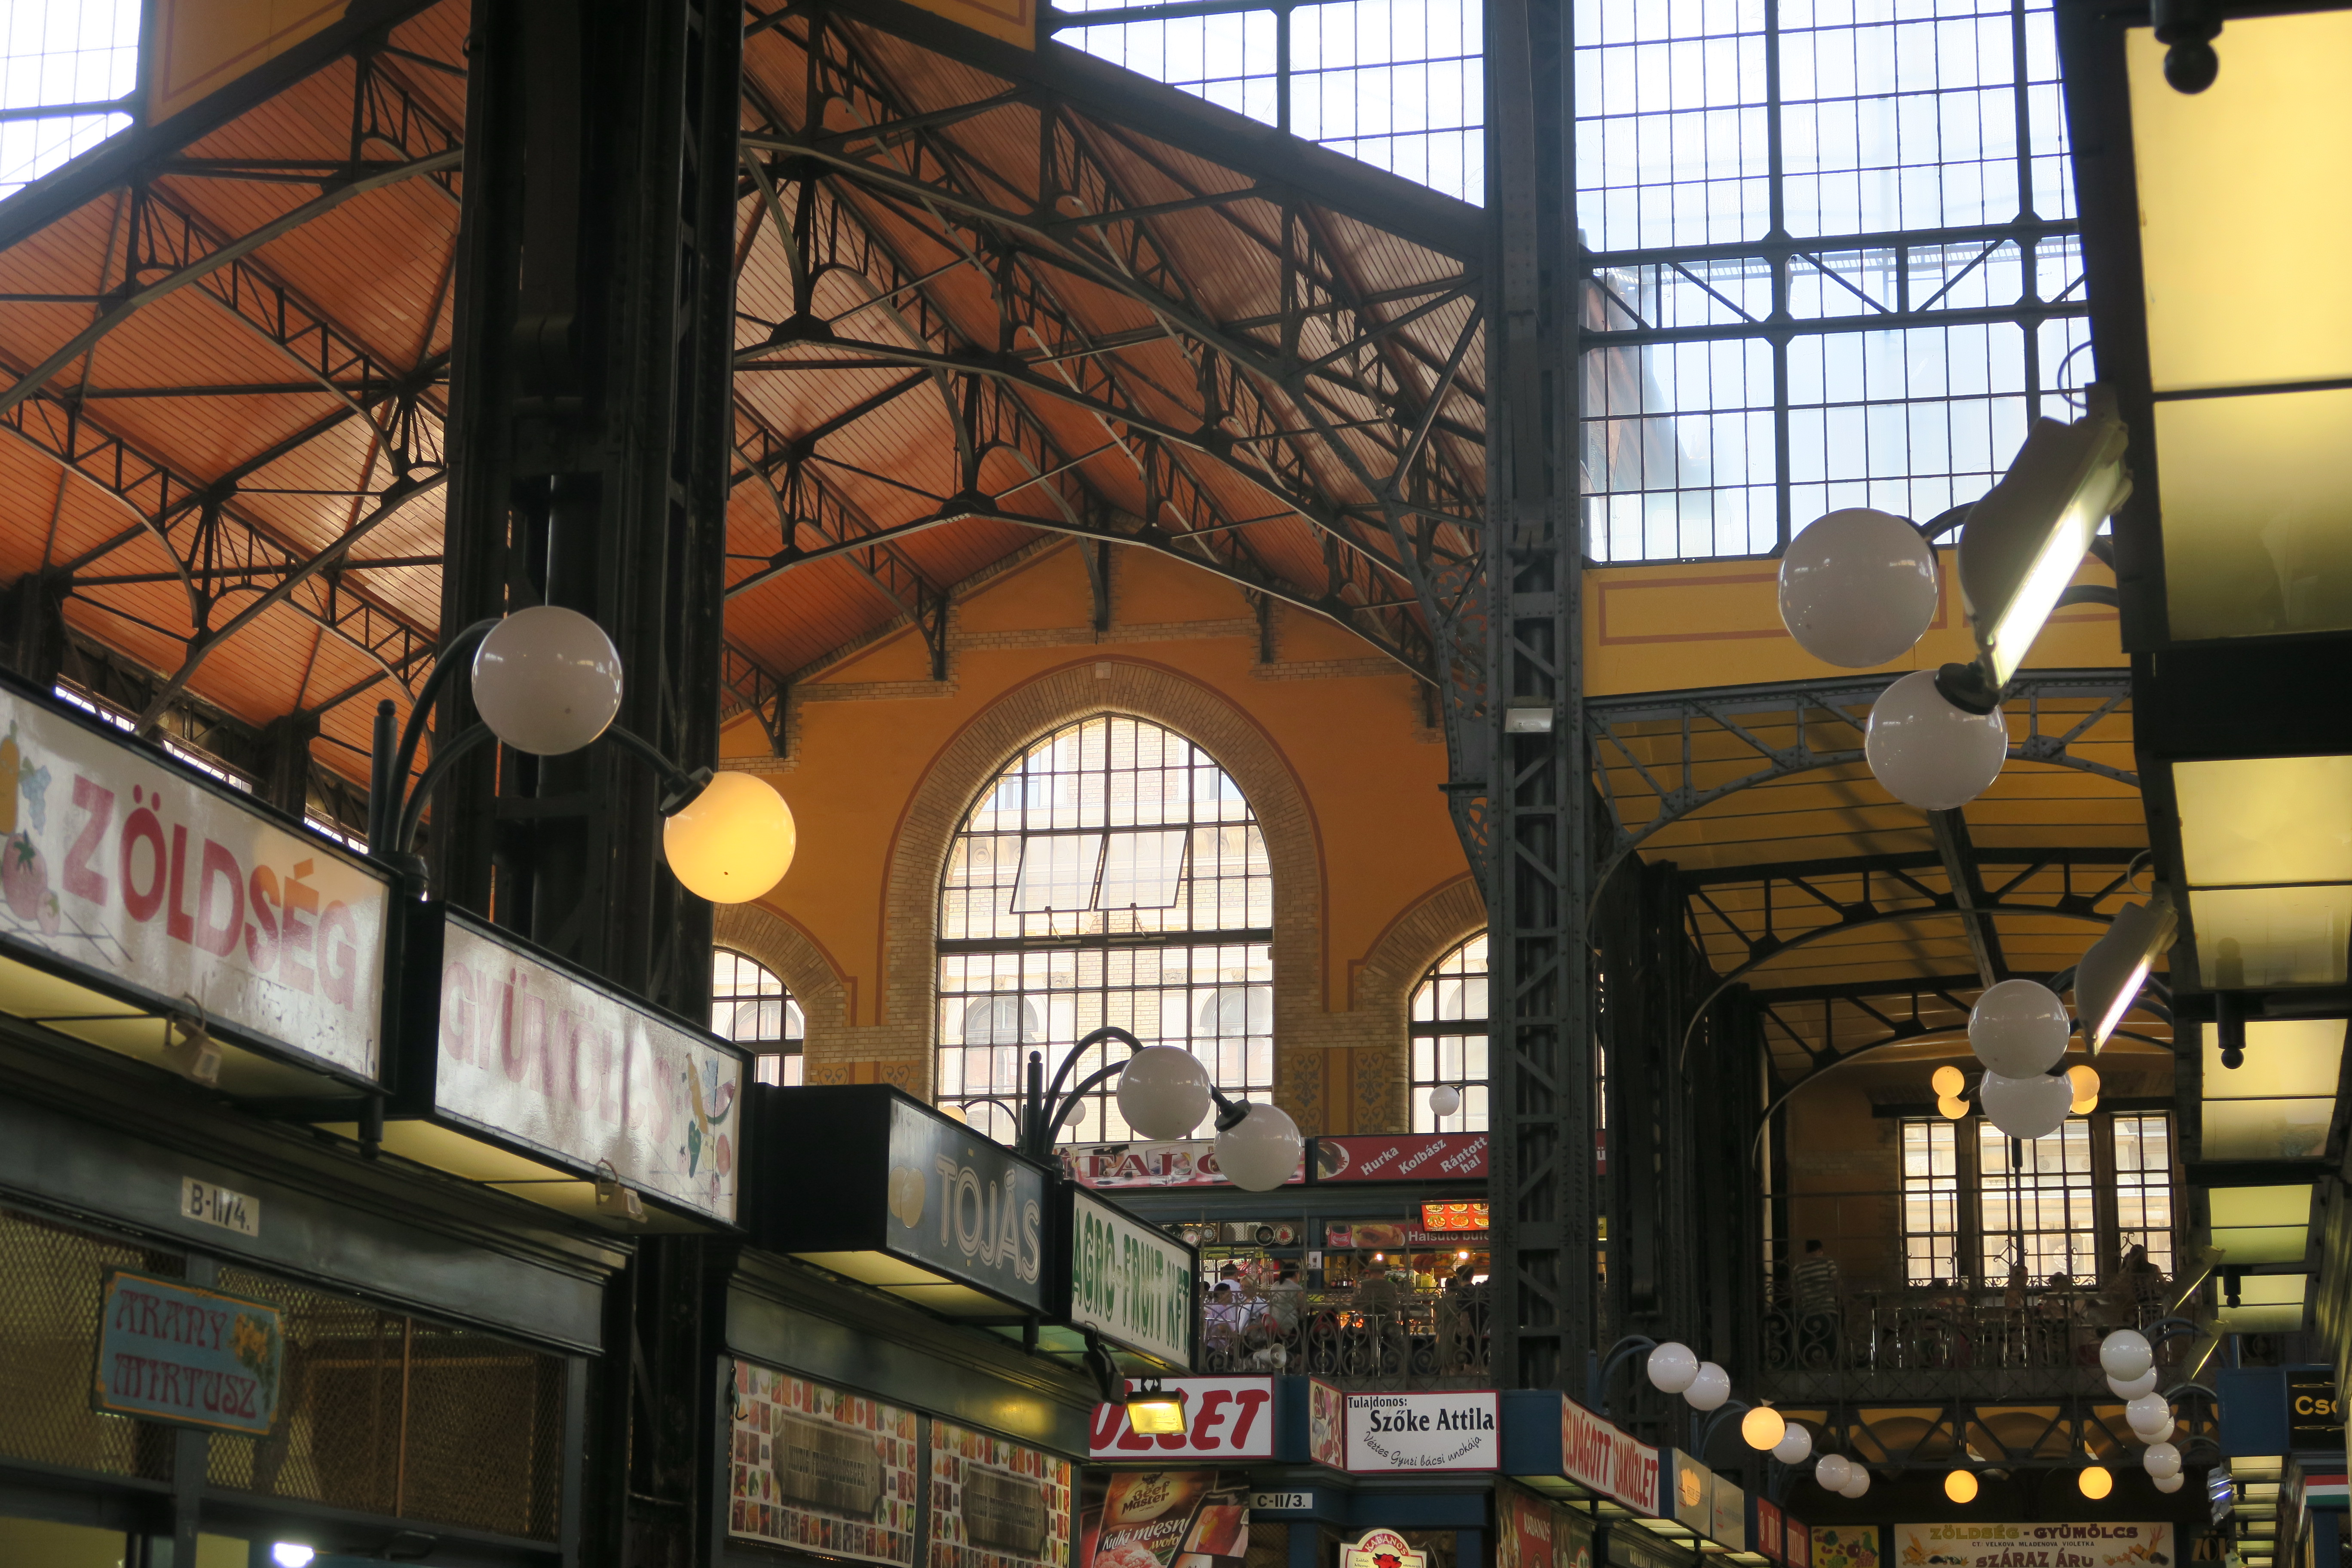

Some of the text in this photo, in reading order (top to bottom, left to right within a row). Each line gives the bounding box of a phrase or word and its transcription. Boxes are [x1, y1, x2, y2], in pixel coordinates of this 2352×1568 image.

[62, 774, 357, 1011] ZÖLDSÉG
[440, 961, 673, 1143] GYÜMÖLCS
[1360, 1147, 1399, 1176] Hurka
[1398, 1139, 1447, 1175] Kolbász
[1440, 1137, 1487, 1173] Rántott
[1459, 1155, 1482, 1174] hal
[935, 1153, 1040, 1284] TOJÁS
[1072, 1207, 1164, 1341] AGRO-FRUIT
[115, 1289, 228, 1351] ARANY
[113, 1353, 257, 1419] MIRTUSZ
[1348, 1396, 1407, 1410] Tulajdonos:
[1370, 1407, 1494, 1432] Szőke Attila
[1363, 1431, 1482, 1467] Vértes Gyuri bácsi unokája
[1563, 1402, 1611, 1486] FELVÁGOTT
[1121, 1492, 1170, 1516] Master
[1132, 1480, 1170, 1501] Beef
[1257, 1494, 1306, 1508] C-II/3.
[1102, 1528, 1133, 1551] Kulki
[1524, 1512, 1550, 1542] KABANOS
[1930, 1524, 2020, 1540] ZÖLDSÉG
[2034, 1523, 2139, 1540] GYÜMÖLCS
[1365, 1535, 1408, 1555] KABANOS
[1975, 1547, 2094, 1568] SZÁRAZ ÁRU
